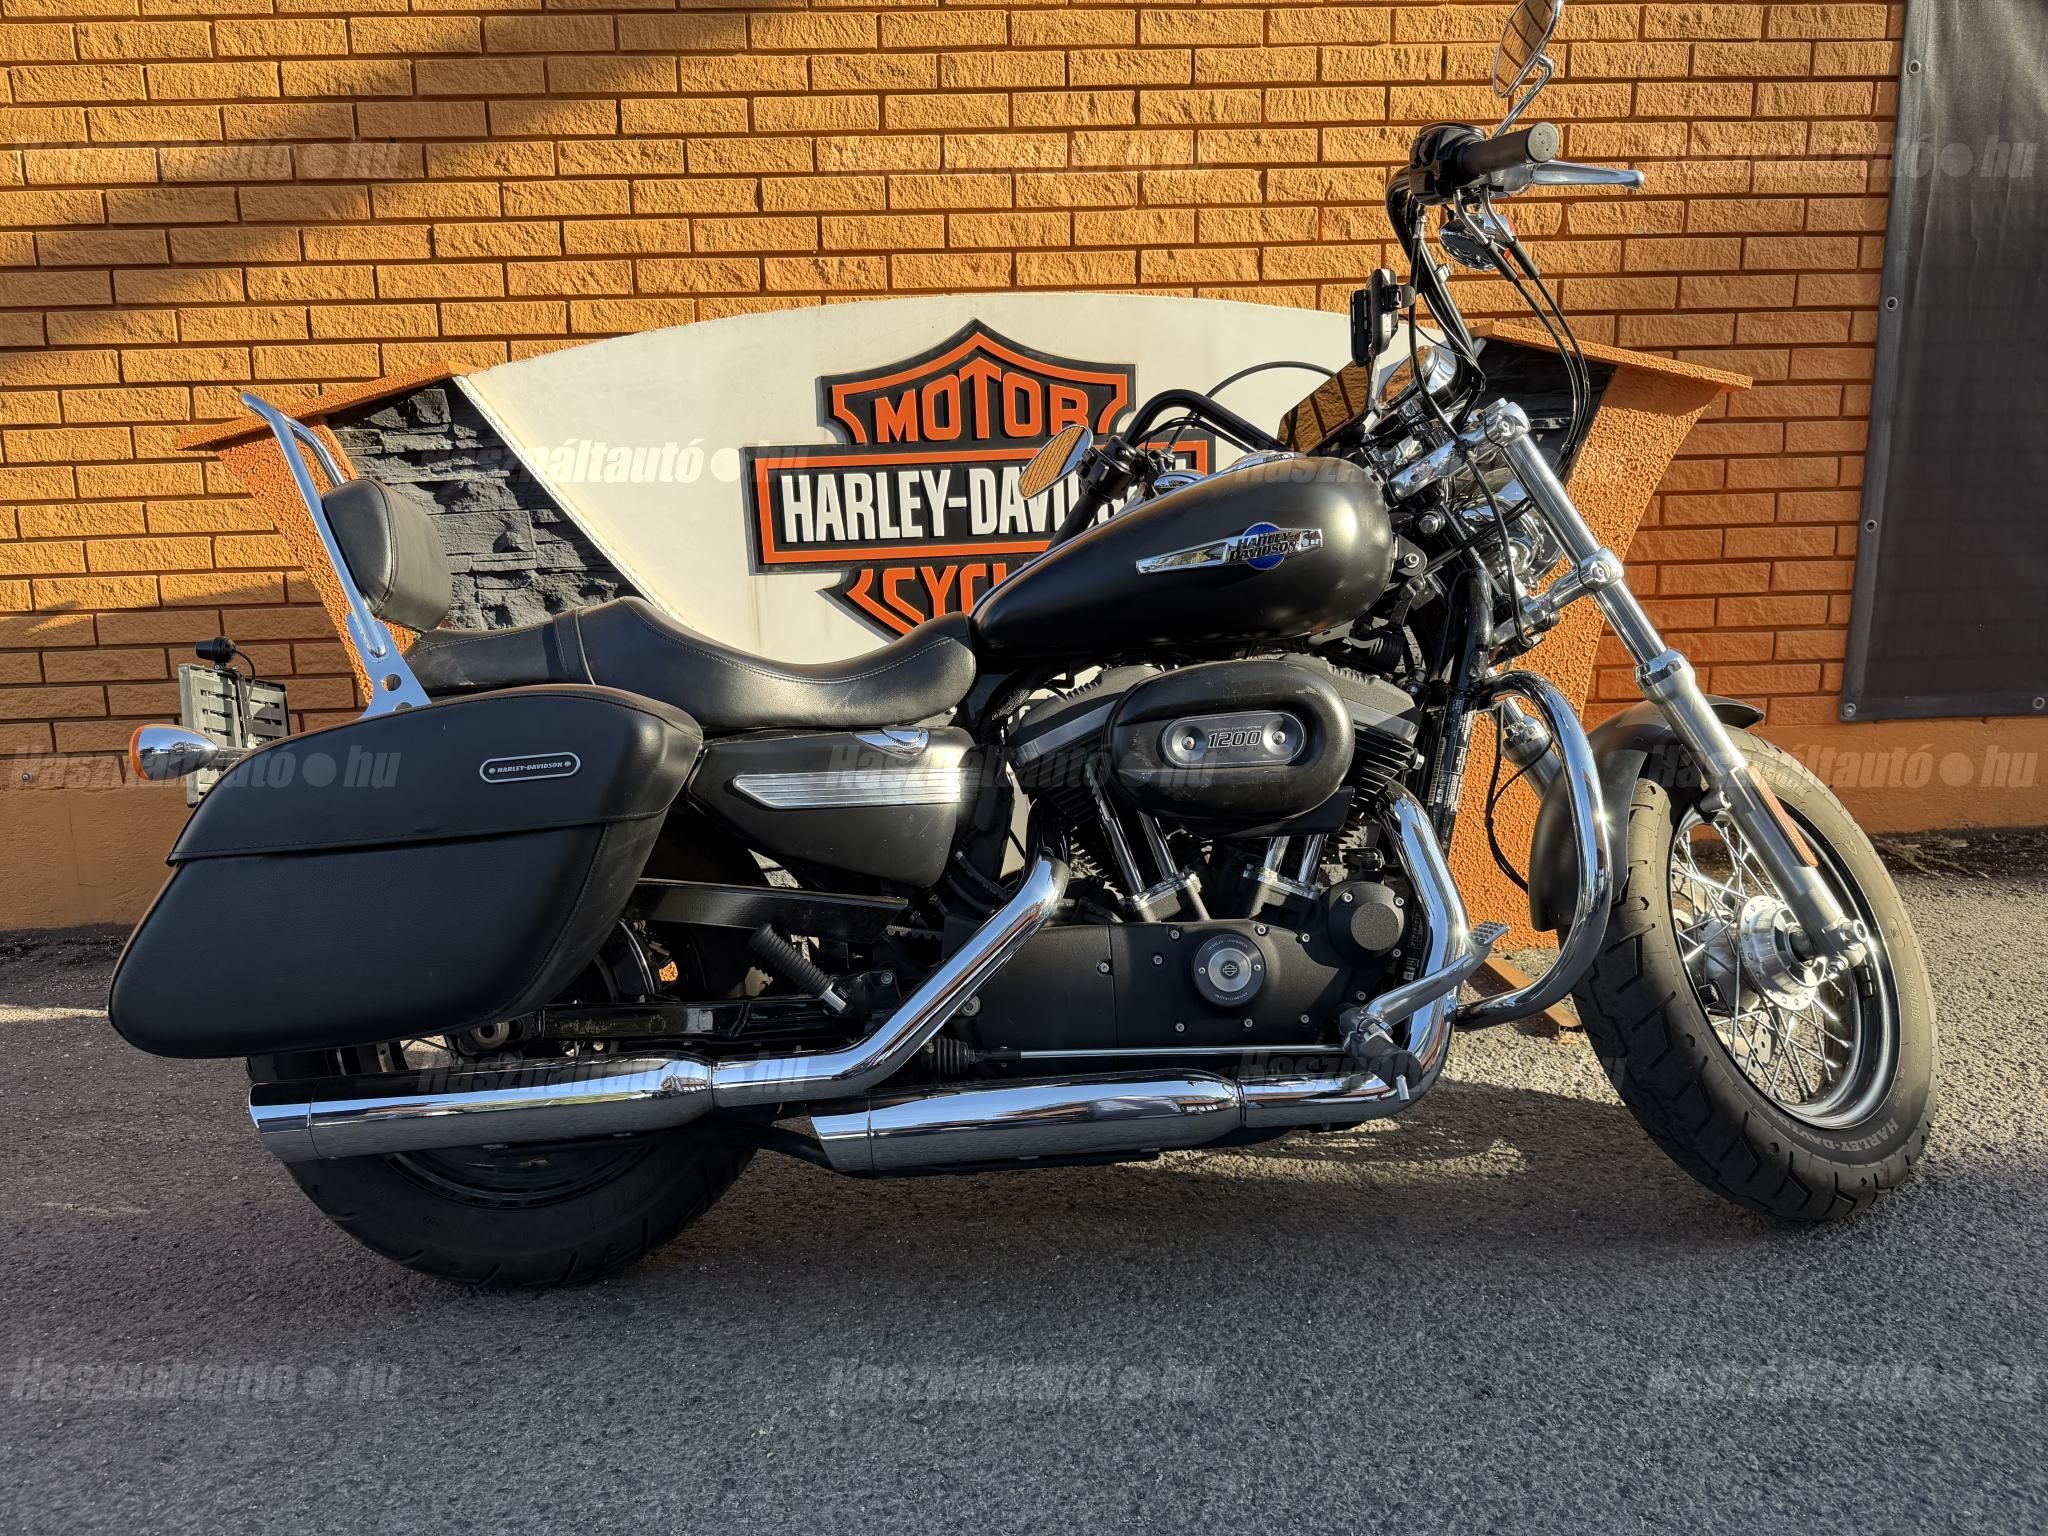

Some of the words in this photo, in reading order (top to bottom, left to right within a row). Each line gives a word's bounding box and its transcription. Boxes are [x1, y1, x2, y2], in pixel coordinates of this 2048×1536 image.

[874, 357, 1089, 443] MOTOR
[1207, 730, 1262, 749] 1200
[496, 761, 563, 774] HARLEY-DAVIDSON
